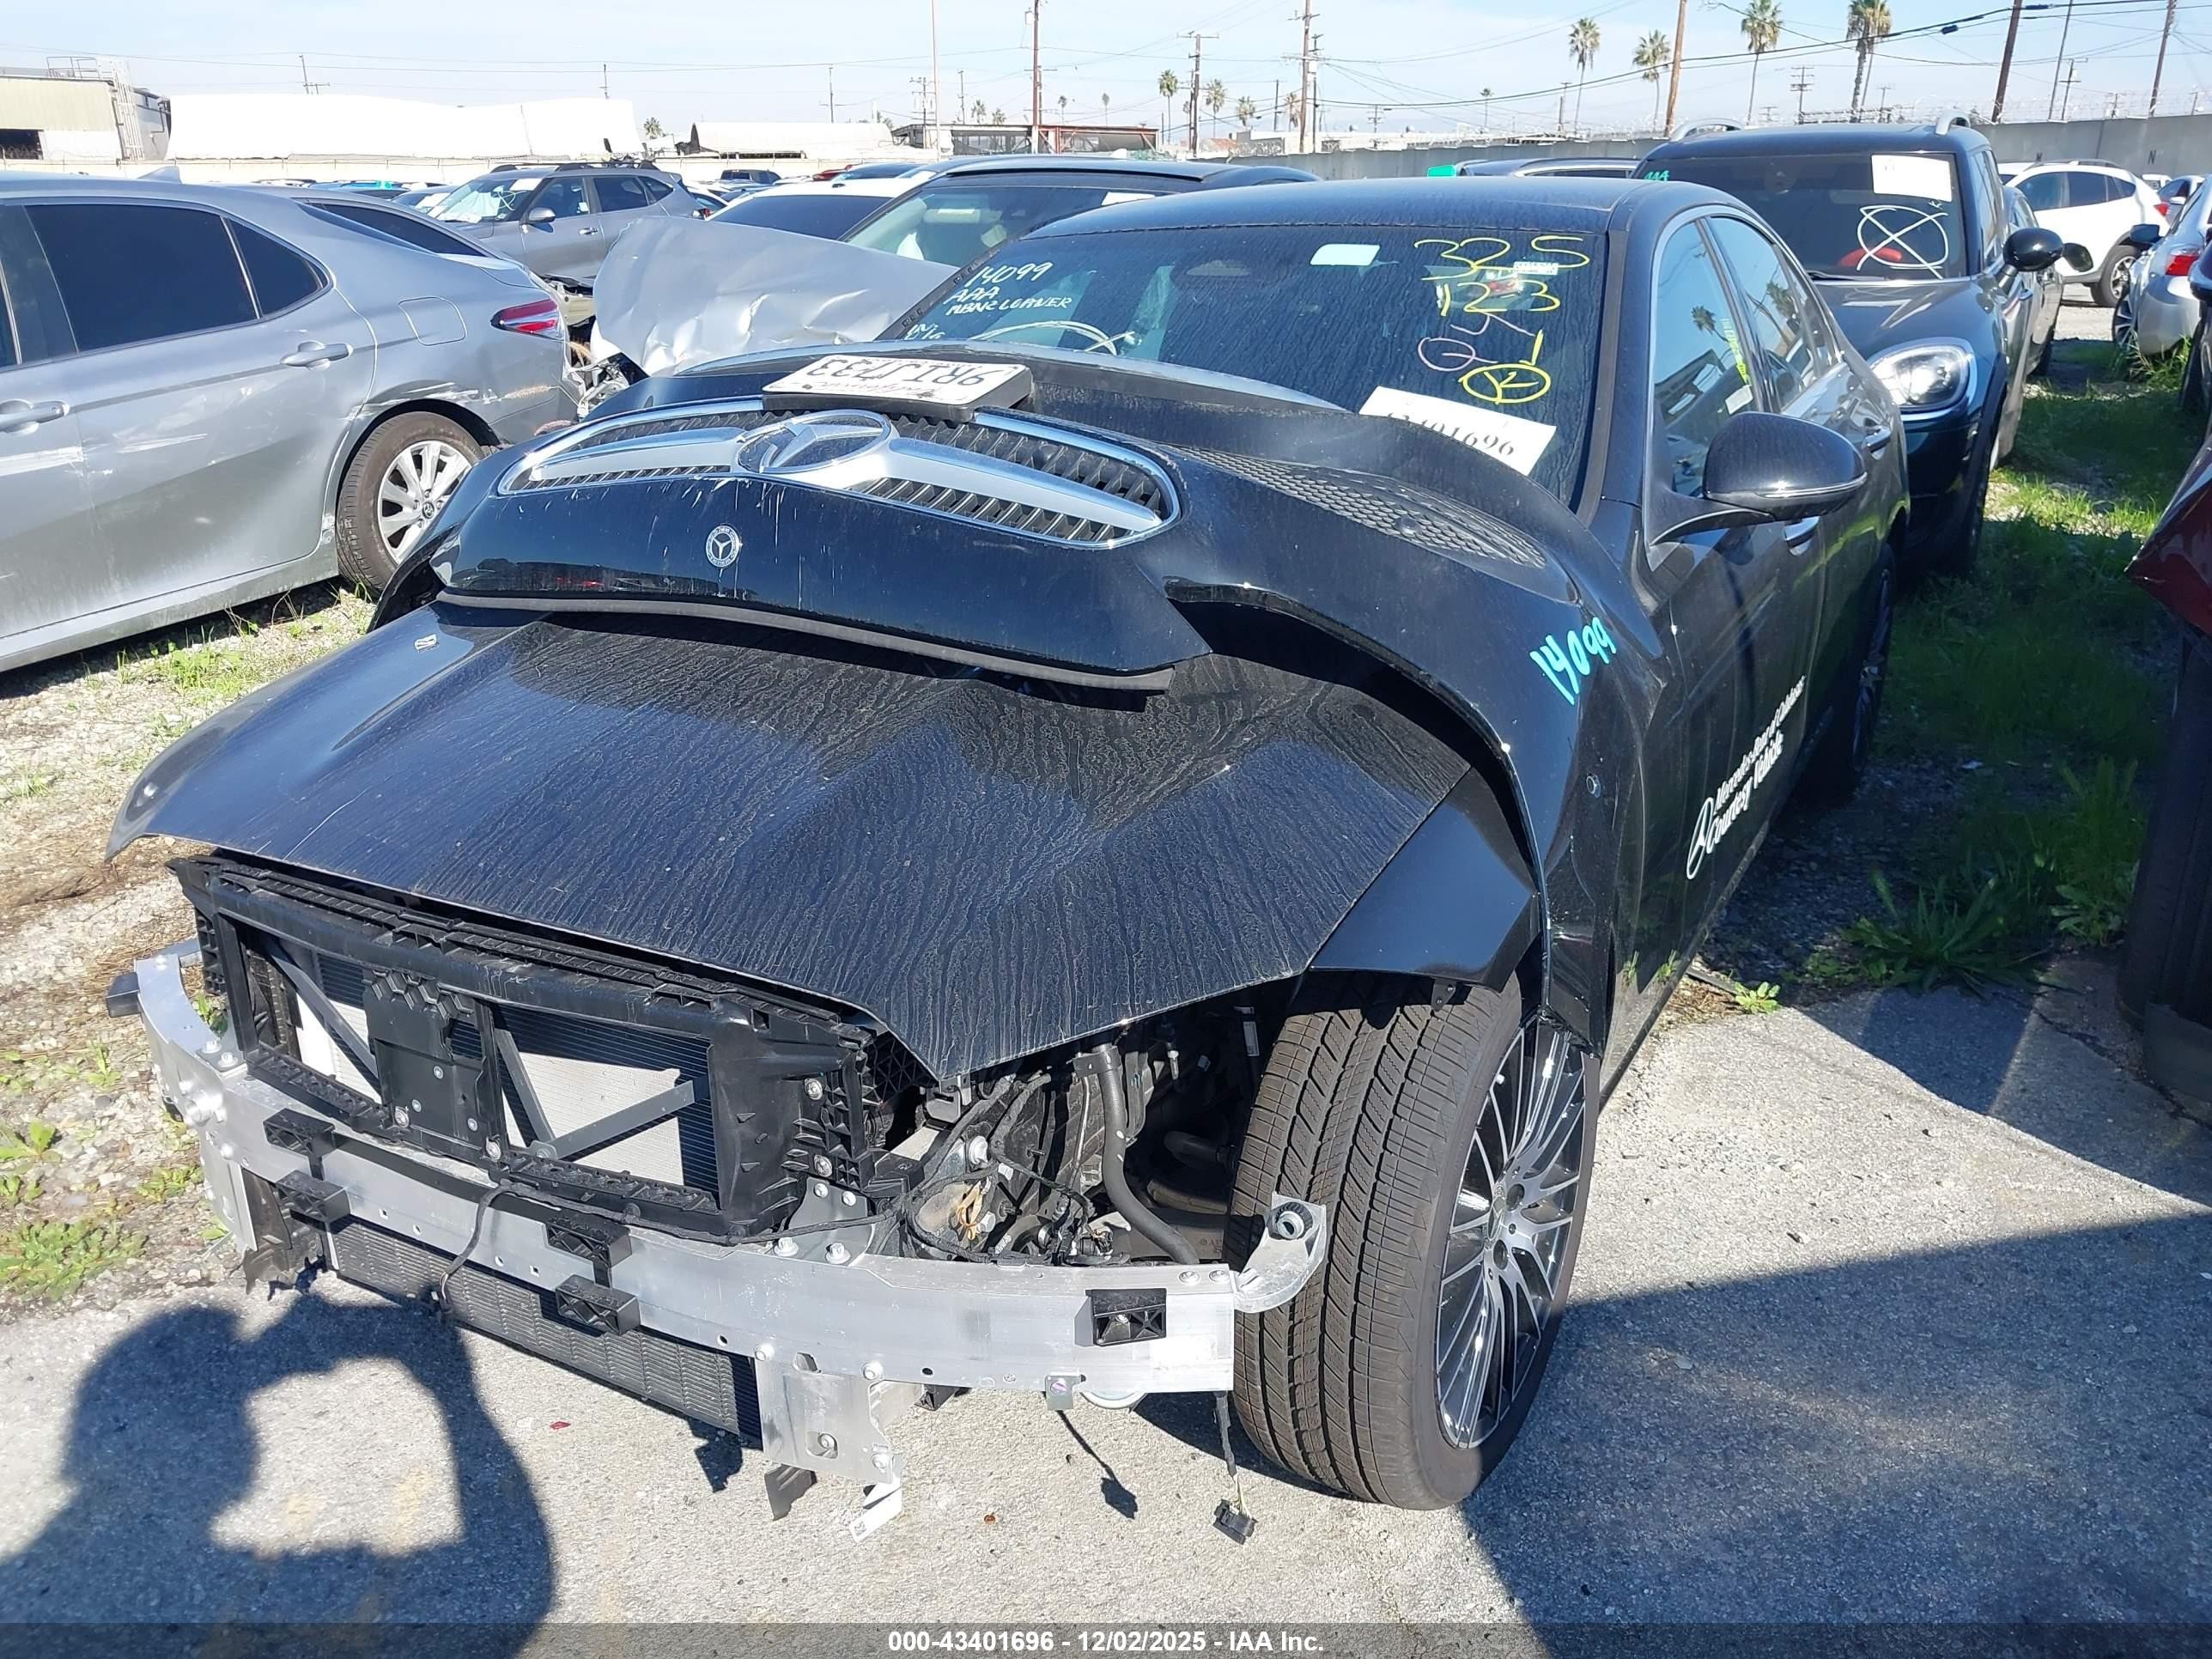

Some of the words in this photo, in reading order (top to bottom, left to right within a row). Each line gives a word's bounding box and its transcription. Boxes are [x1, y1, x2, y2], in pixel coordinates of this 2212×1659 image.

[965, 262, 1054, 287] 14099
[1414, 235, 1589, 281] 325
[944, 286, 1000, 305] AAA
[807, 358, 1003, 386] 9RIJ733
[1529, 617, 1616, 705] 14099
[1706, 776, 1753, 854] Courtesy
[1753, 729, 1784, 789] Vehicle
